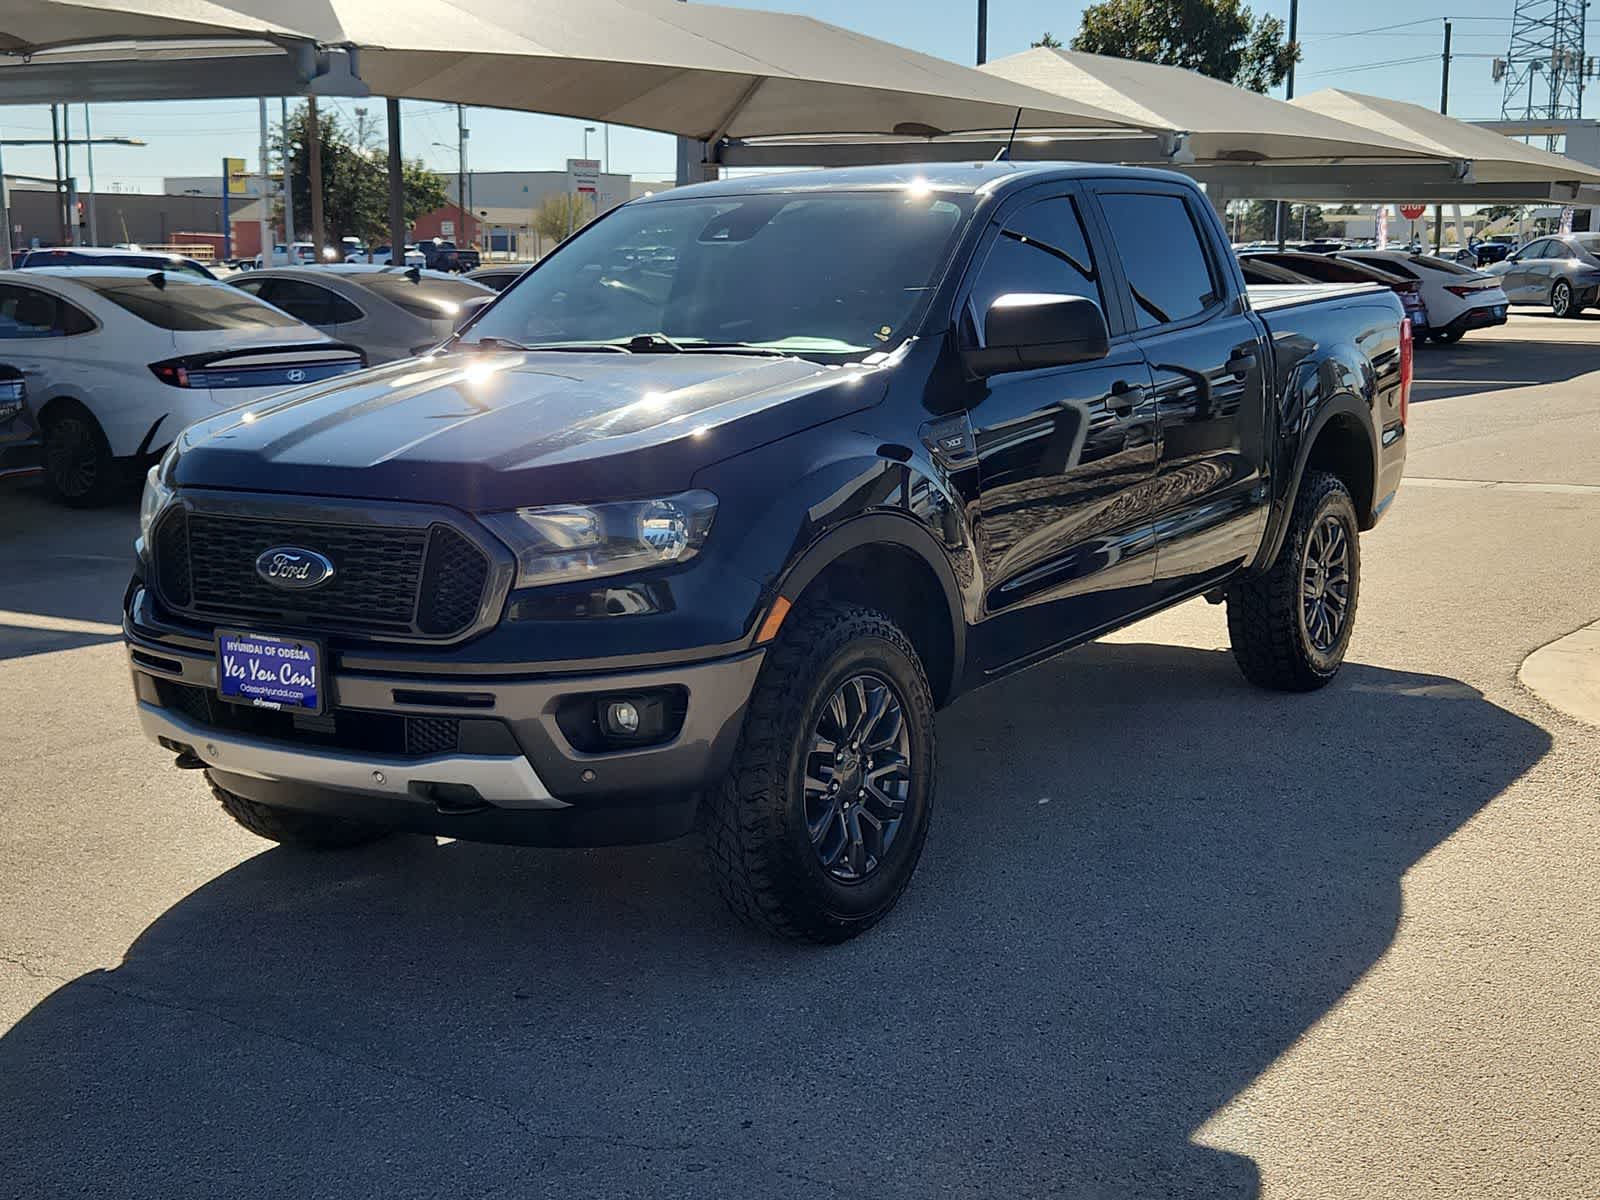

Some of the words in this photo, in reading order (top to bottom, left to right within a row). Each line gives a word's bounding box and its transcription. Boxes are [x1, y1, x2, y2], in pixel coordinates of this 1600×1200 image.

[269, 553, 311, 579] Ford
[227, 641, 263, 655] HYUNDAI
[264, 647, 276, 656] OF
[277, 648, 311, 660] ODESSA
[223, 655, 246, 679] Yes
[249, 658, 277, 680] You
[280, 663, 315, 688] Can!
